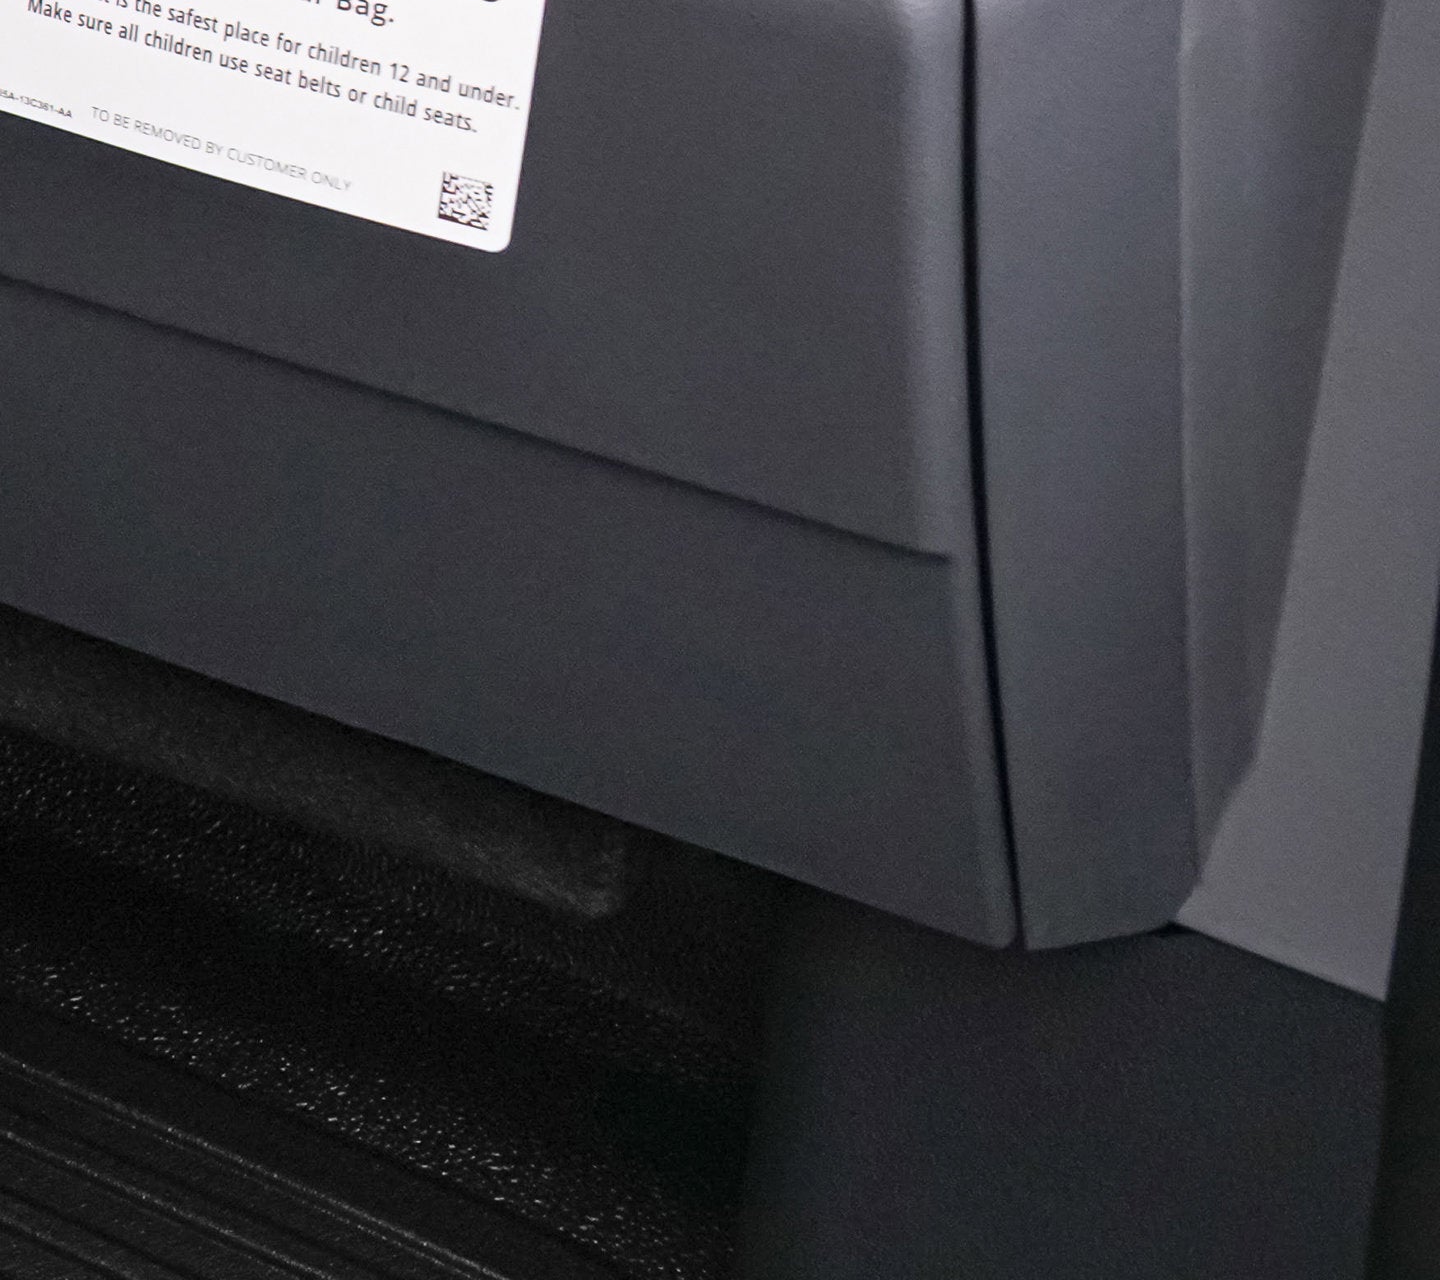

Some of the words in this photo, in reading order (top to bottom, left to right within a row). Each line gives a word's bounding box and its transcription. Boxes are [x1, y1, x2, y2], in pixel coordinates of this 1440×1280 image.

[77, 12, 113, 35] sure
[118, 23, 139, 43] all
[144, 29, 213, 64] children
[219, 55, 249, 74] use
[254, 61, 292, 86] seat
[298, 69, 341, 98] belts
[348, 88, 368, 104] or
[373, 91, 417, 117] child
[423, 106, 478, 133] seats.
[167, 6, 218, 34] safest
[223, 20, 270, 47] place
[276, 32, 302, 55] for
[307, 42, 381, 77] children
[389, 62, 410, 83] 12
[415, 73, 452, 93] and
[458, 81, 521, 111] under.
[91, 106, 110, 123] TO
[113, 113, 131, 129] BE
[134, 119, 202, 151] REMOVED
[205, 141, 223, 157] BY
[227, 148, 307, 182] CUSTOMER
[311, 170, 352, 192] ONLY
